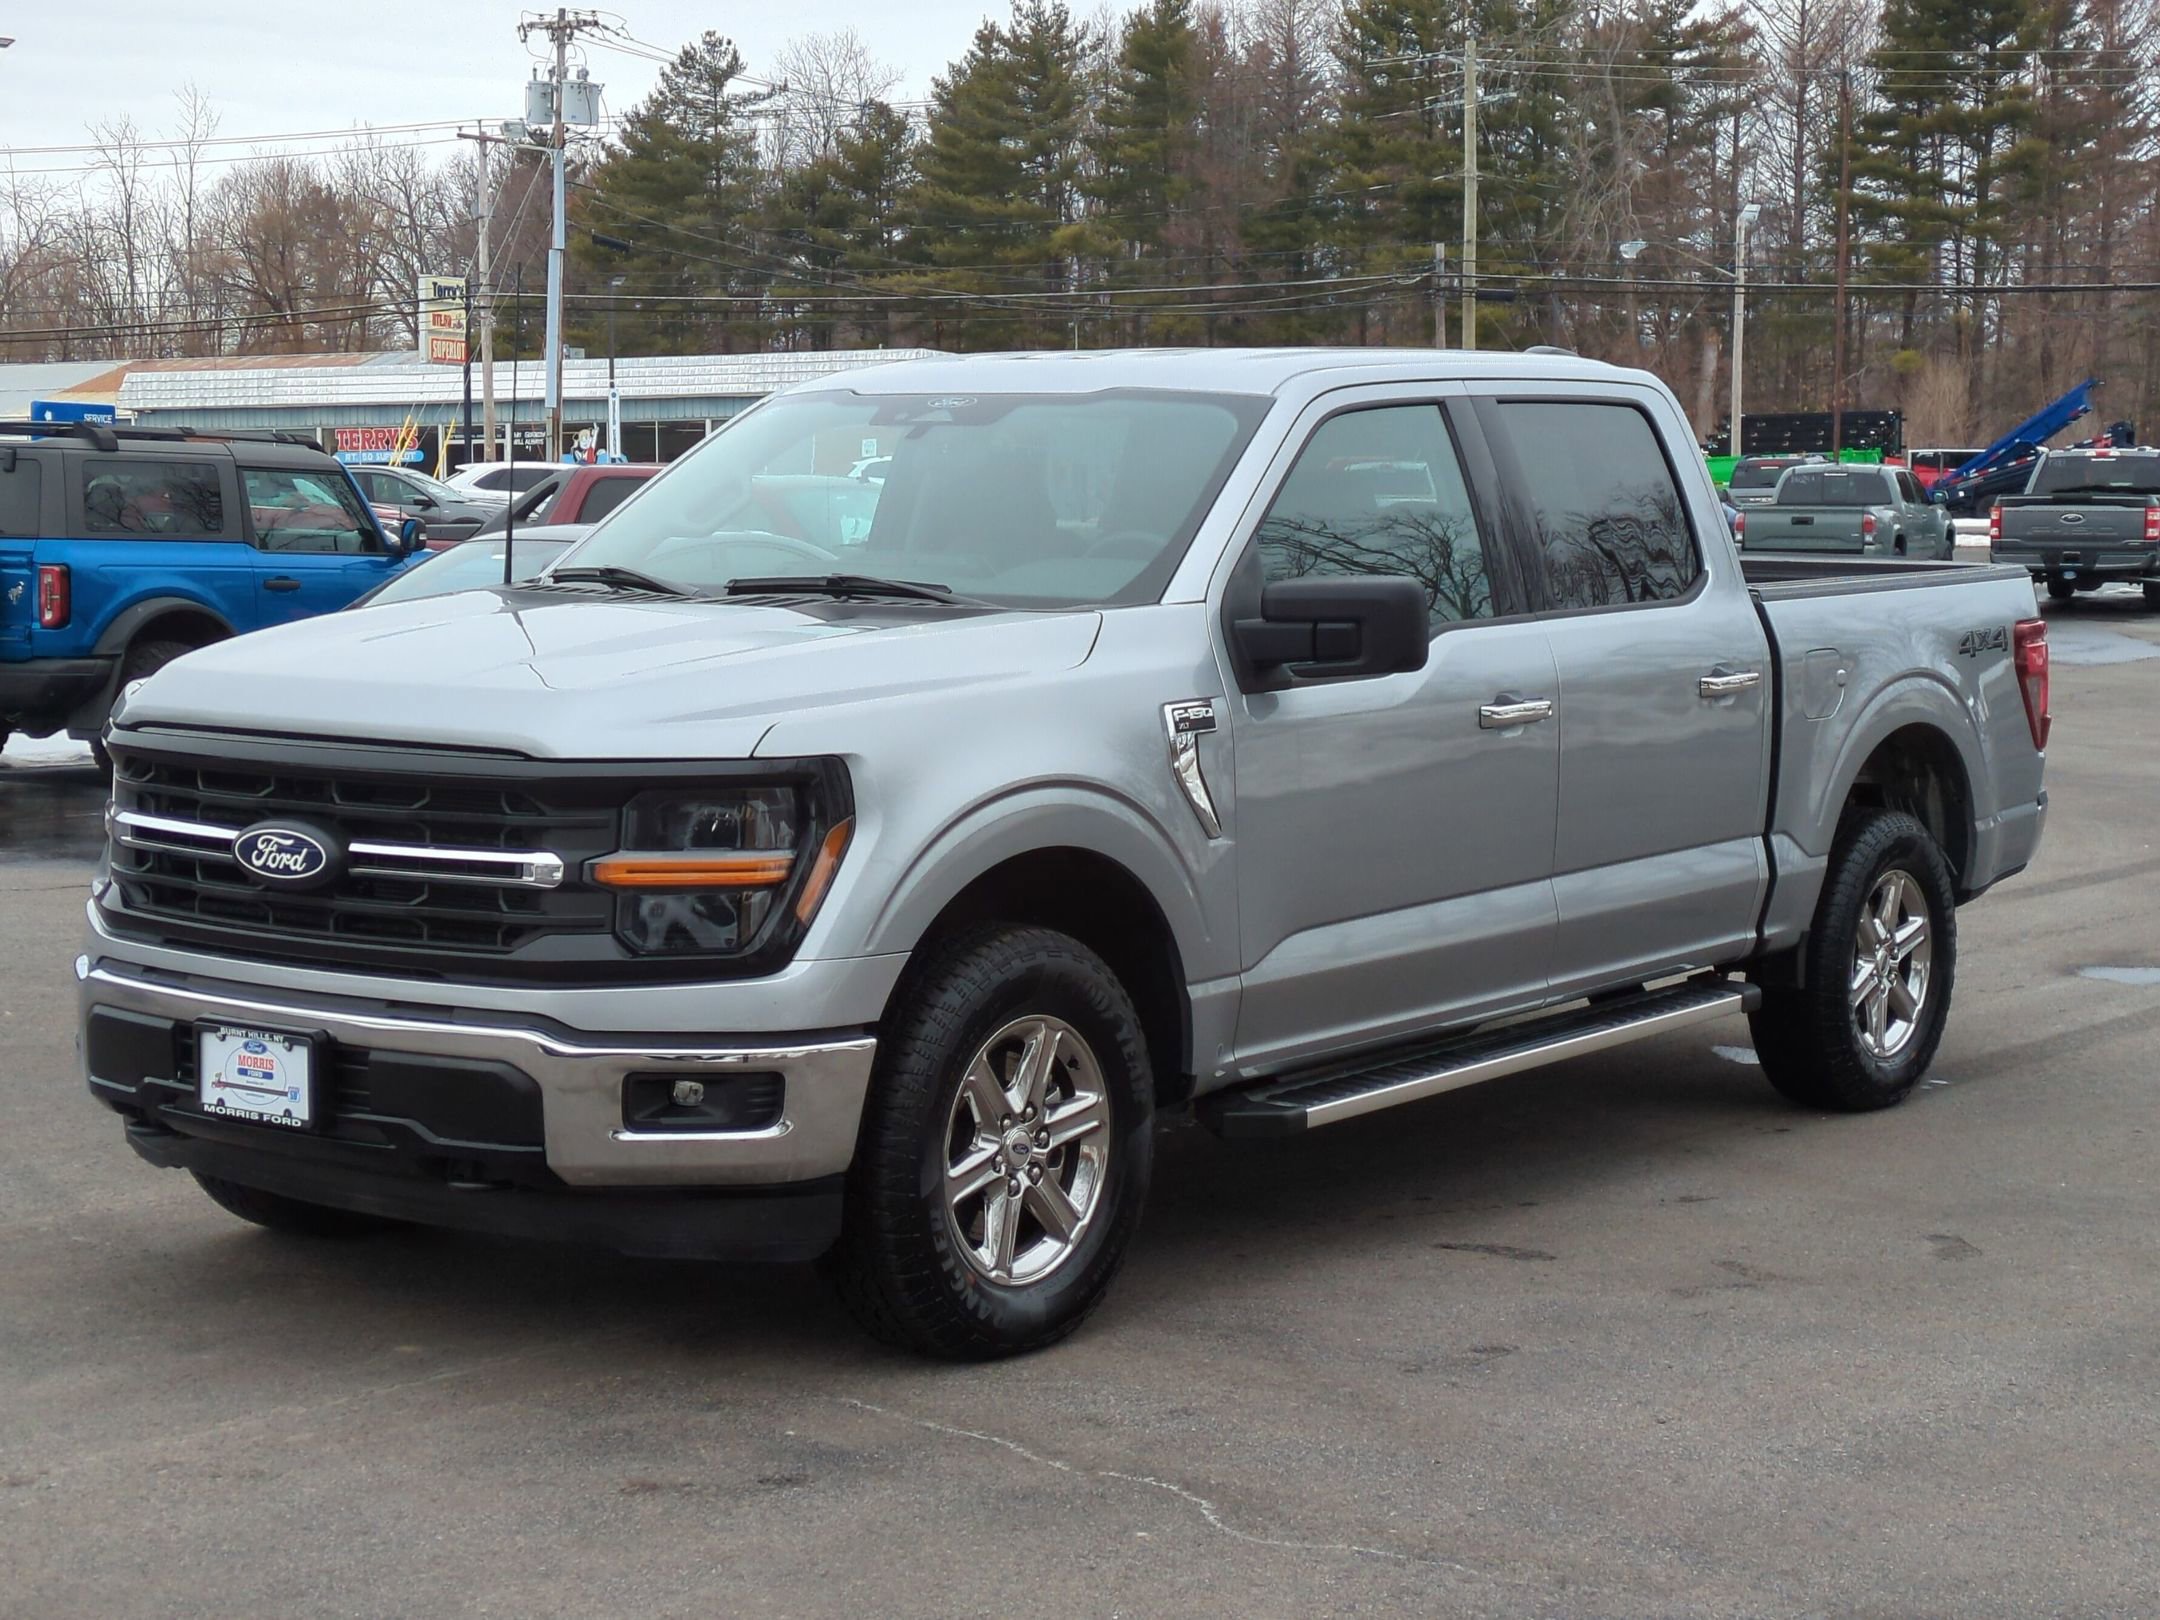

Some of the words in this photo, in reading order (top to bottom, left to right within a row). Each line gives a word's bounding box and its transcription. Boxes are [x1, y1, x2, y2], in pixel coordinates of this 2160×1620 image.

[432, 340, 465, 360] SUPERLOT
[83, 413, 113, 424] SERVICE
[335, 428, 418, 451] TERRYS
[375, 453, 416, 462] SUPLOT
[252, 835, 308, 871] Ford
[238, 1055, 274, 1070] MORRIS
[204, 1104, 259, 1120] MORRIS
[263, 1114, 302, 1127] FORD
